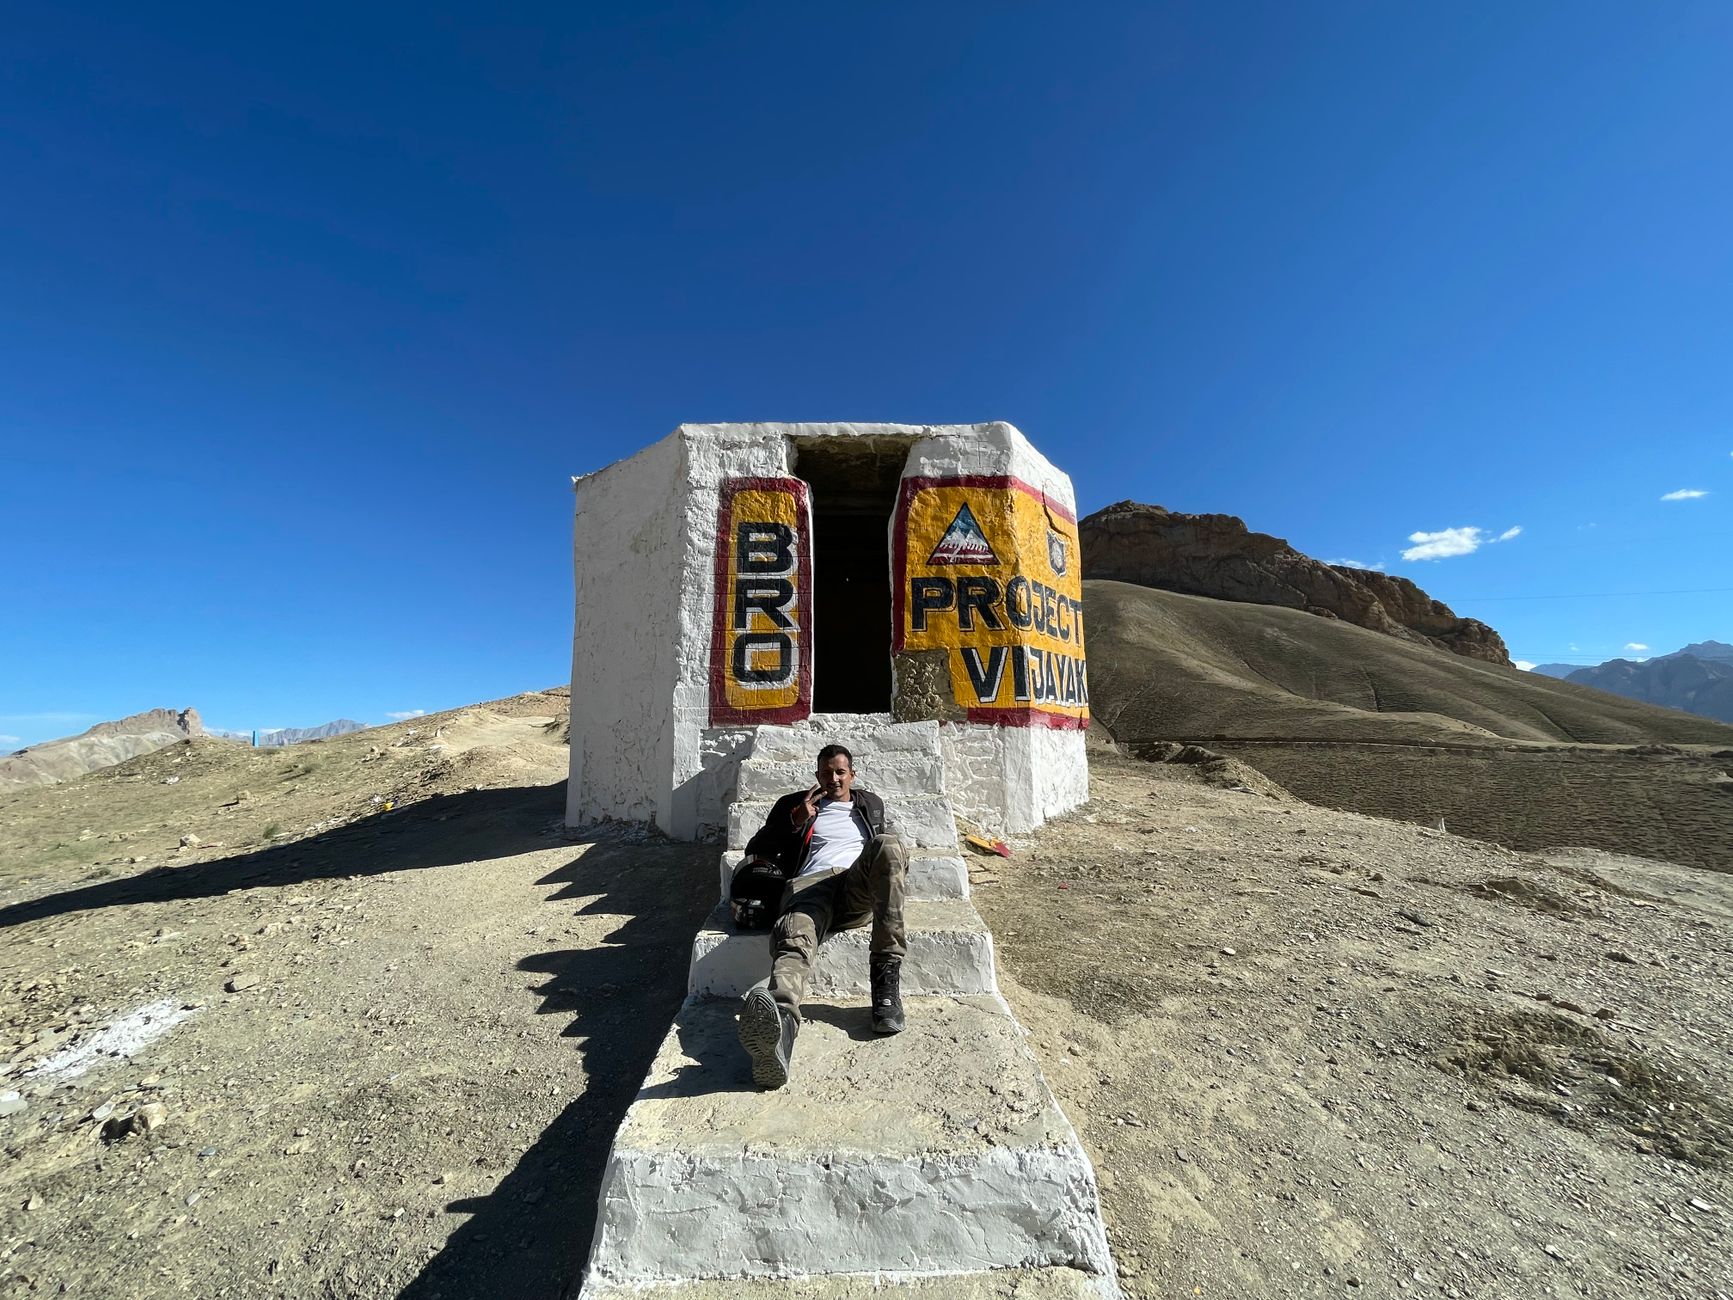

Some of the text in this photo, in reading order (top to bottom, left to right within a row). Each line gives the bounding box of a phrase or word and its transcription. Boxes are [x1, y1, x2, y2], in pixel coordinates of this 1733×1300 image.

[732, 521, 800, 690] BRO
[911, 575, 1084, 648] PROJECT
[960, 645, 1089, 708] VIJAYAK
